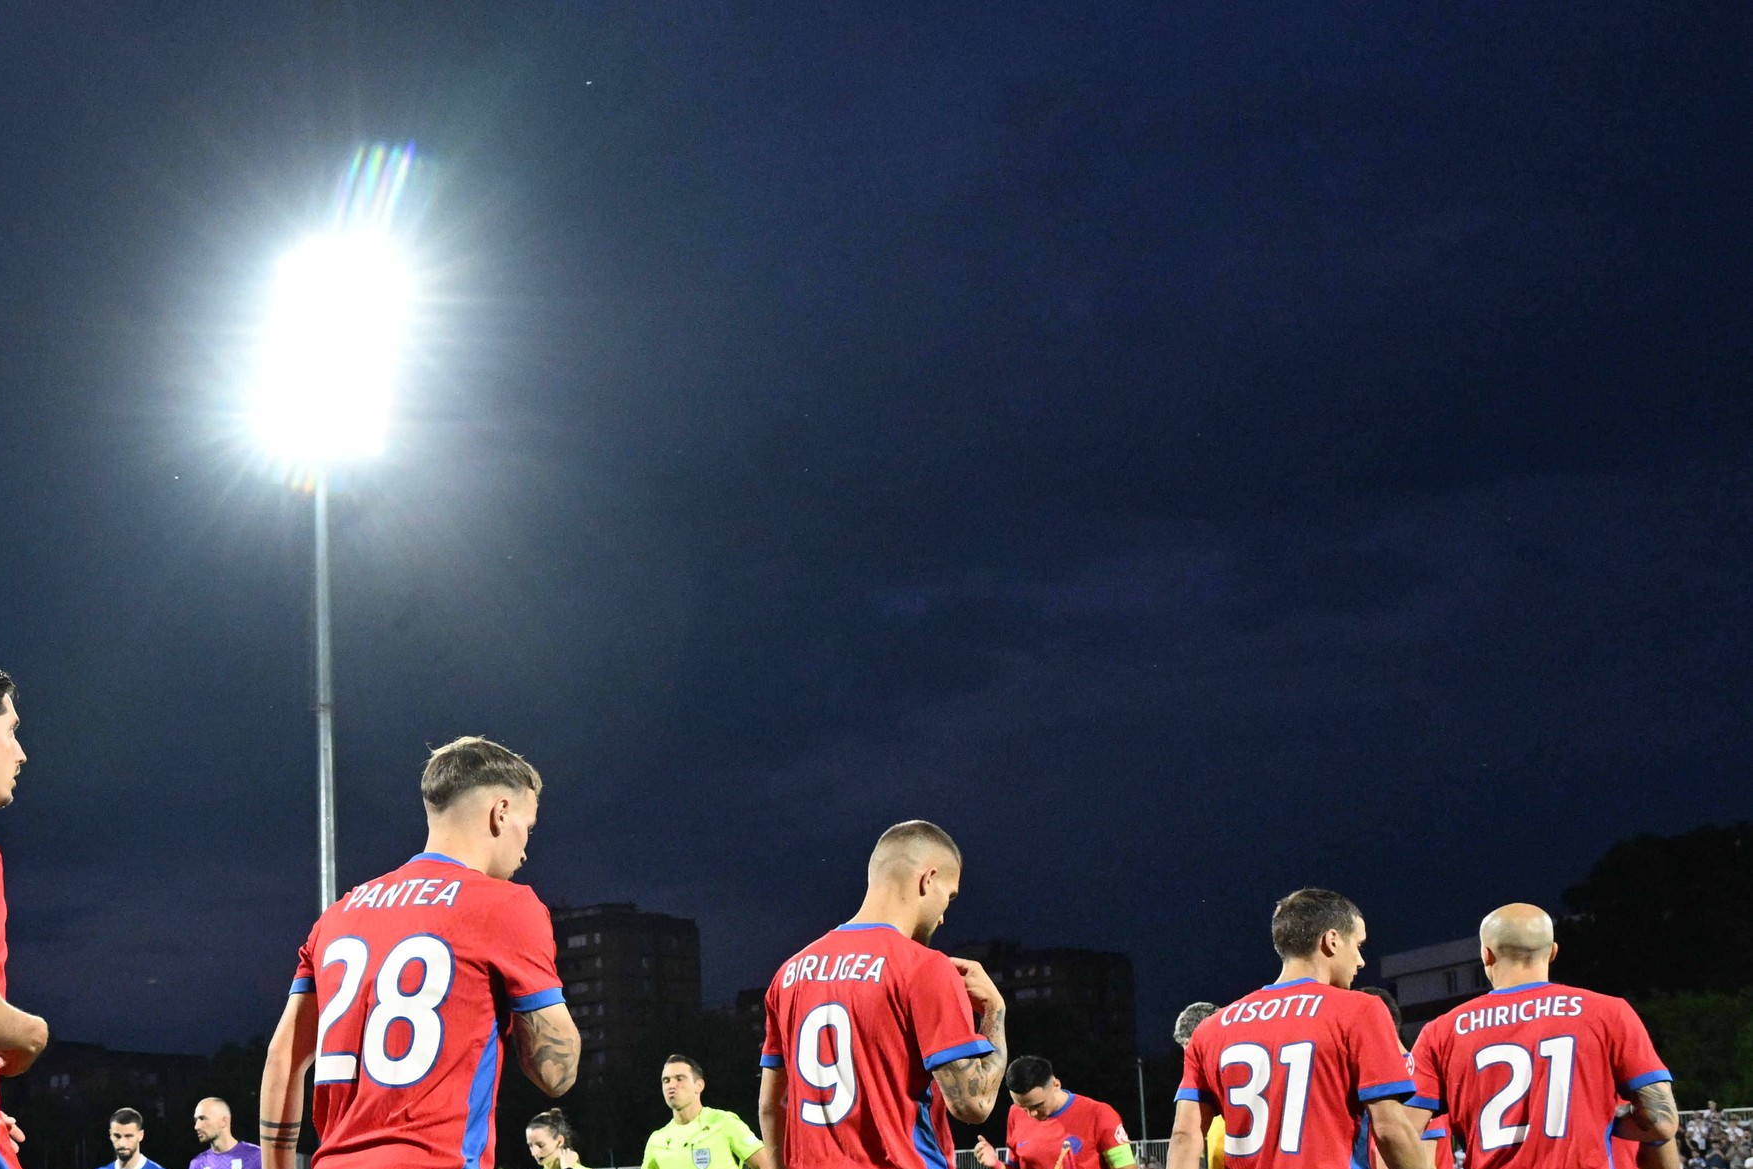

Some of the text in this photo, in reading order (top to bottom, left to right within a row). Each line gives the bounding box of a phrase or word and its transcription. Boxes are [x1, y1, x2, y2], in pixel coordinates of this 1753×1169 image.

[345, 878, 463, 911] PANTEA
[314, 932, 456, 1088] 28
[782, 953, 887, 989] BIRLIGEA
[1220, 993, 1324, 1027] CISOTTI
[1454, 995, 1584, 1035] CHIRICHES
[796, 1001, 858, 1126] 9
[1220, 1040, 1316, 1157] 31
[1474, 1034, 1577, 1152] 21
